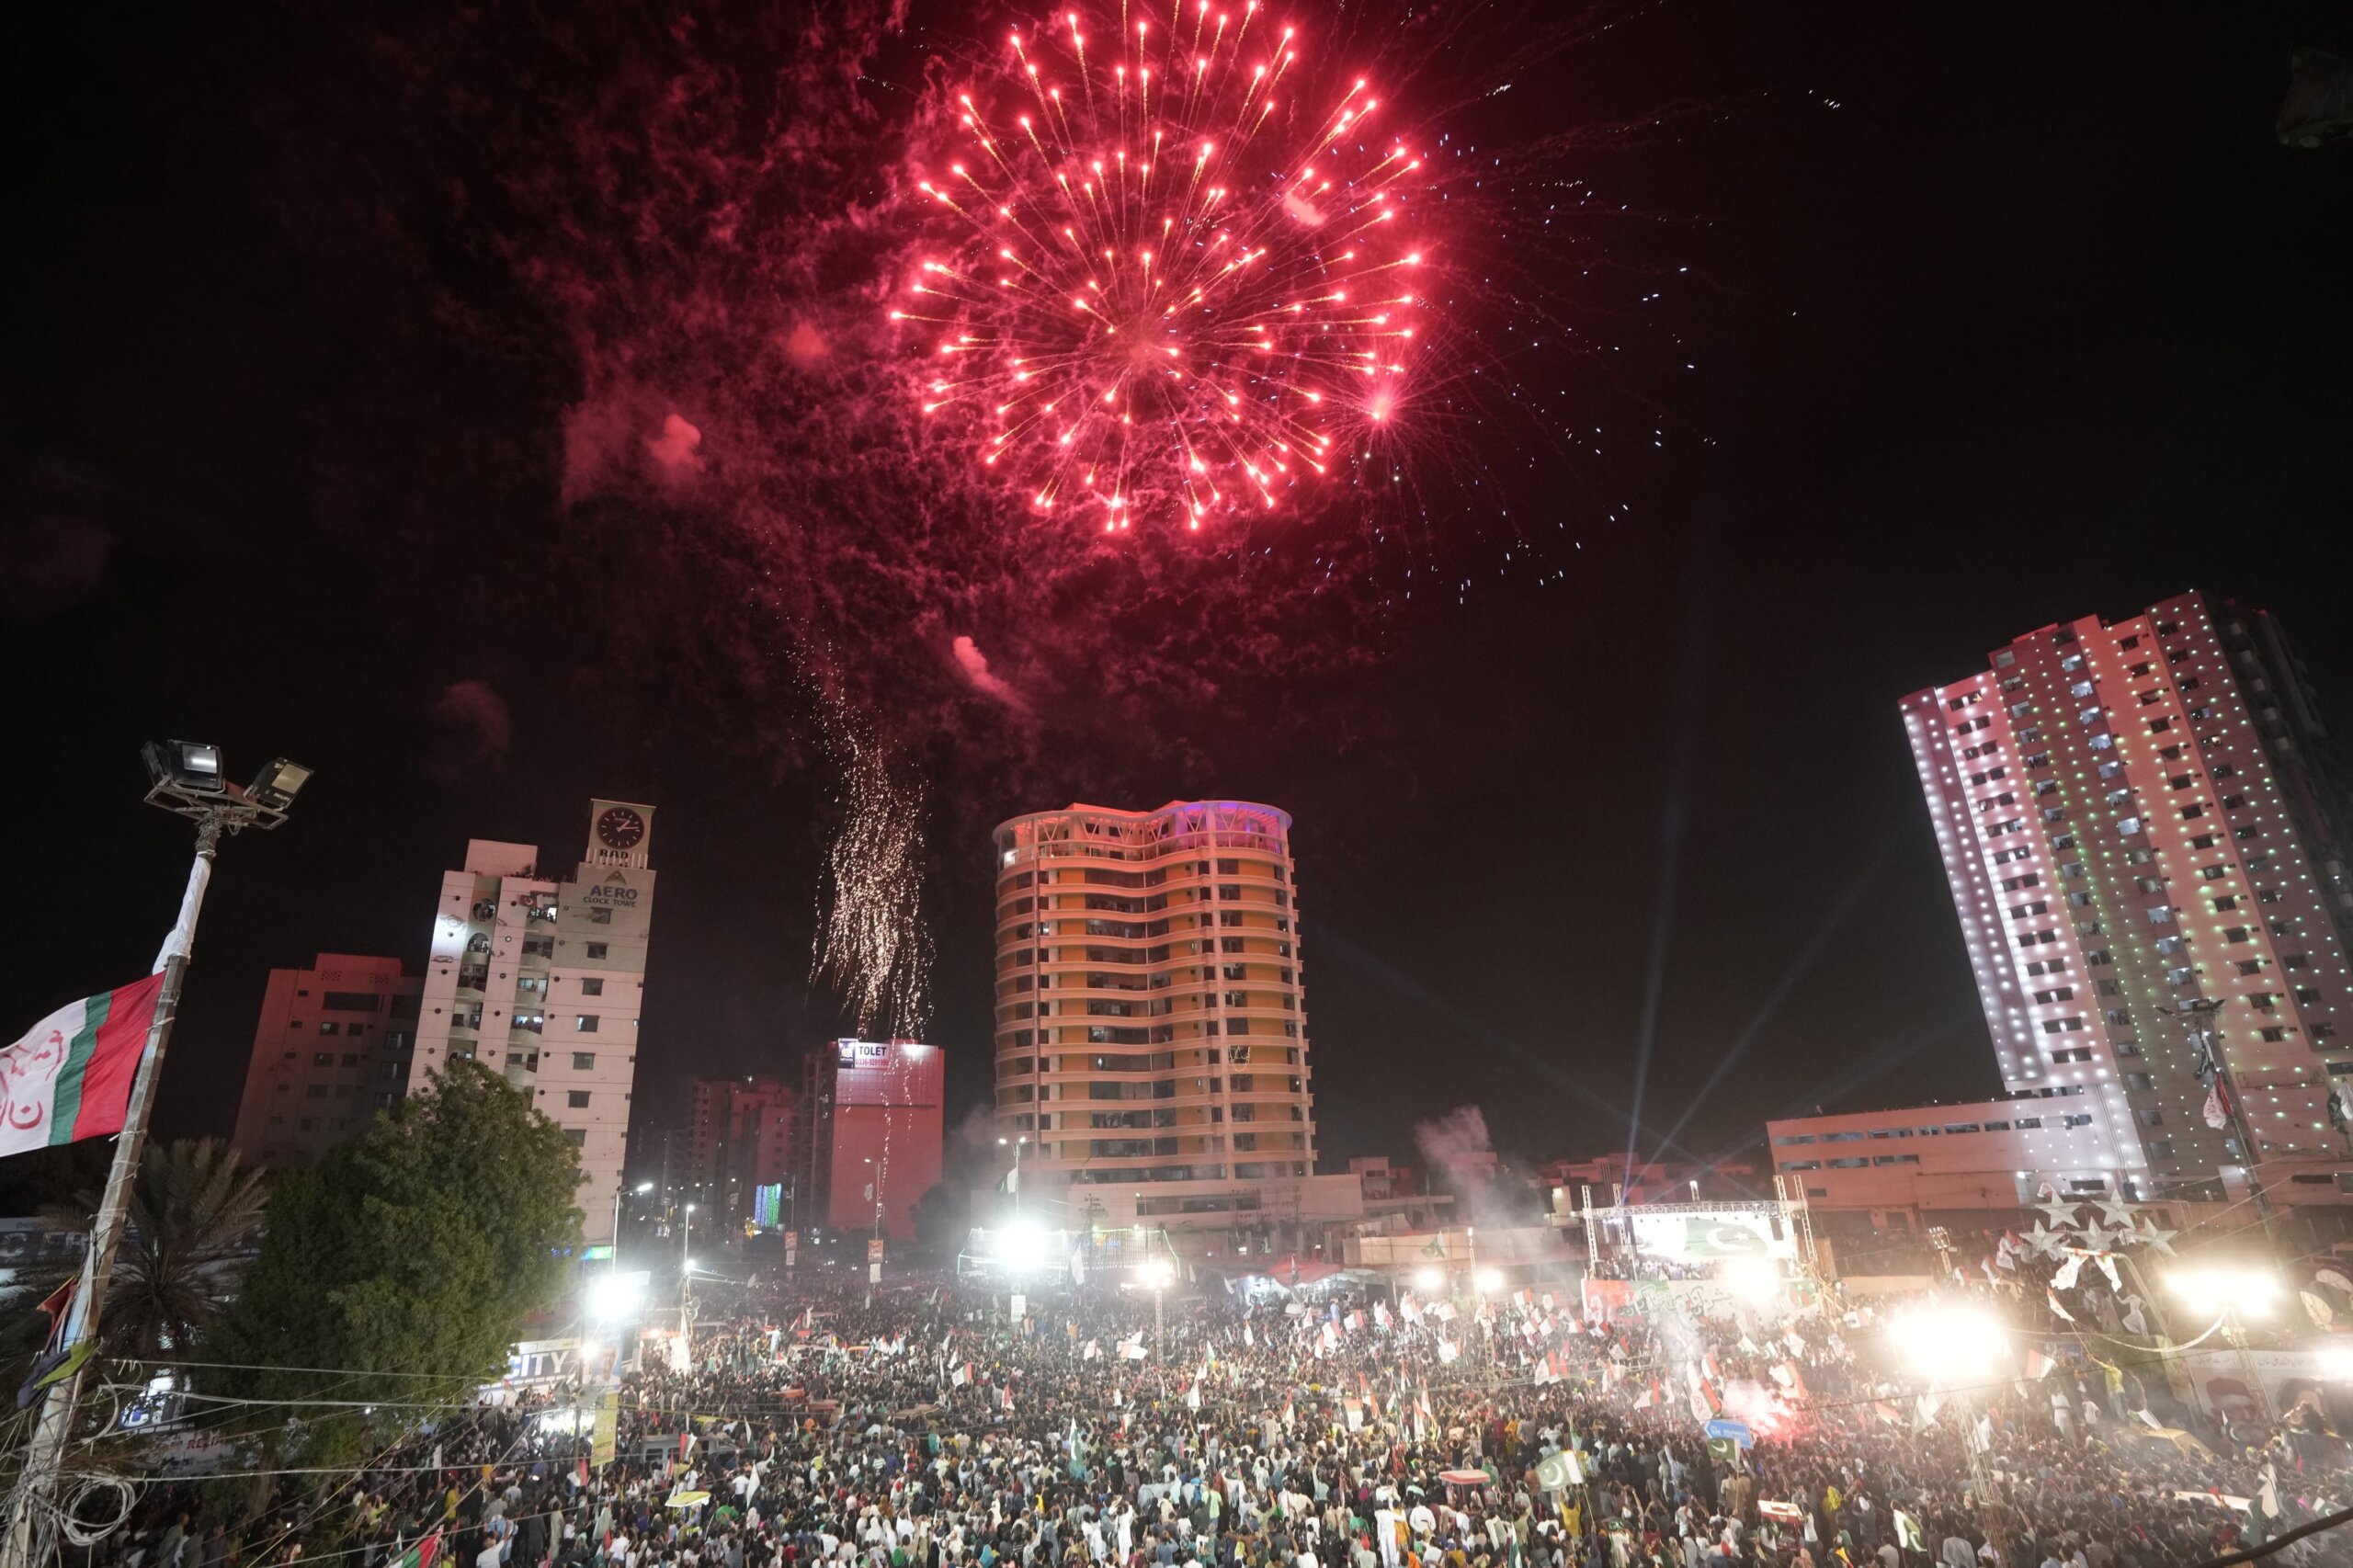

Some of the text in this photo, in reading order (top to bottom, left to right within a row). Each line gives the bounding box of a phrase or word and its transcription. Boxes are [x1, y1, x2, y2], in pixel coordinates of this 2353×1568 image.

[590, 885, 638, 900] AERO
[583, 896, 609, 904] CLOCK
[858, 1046, 887, 1056] TOLET
[507, 1351, 570, 1379] CITY
